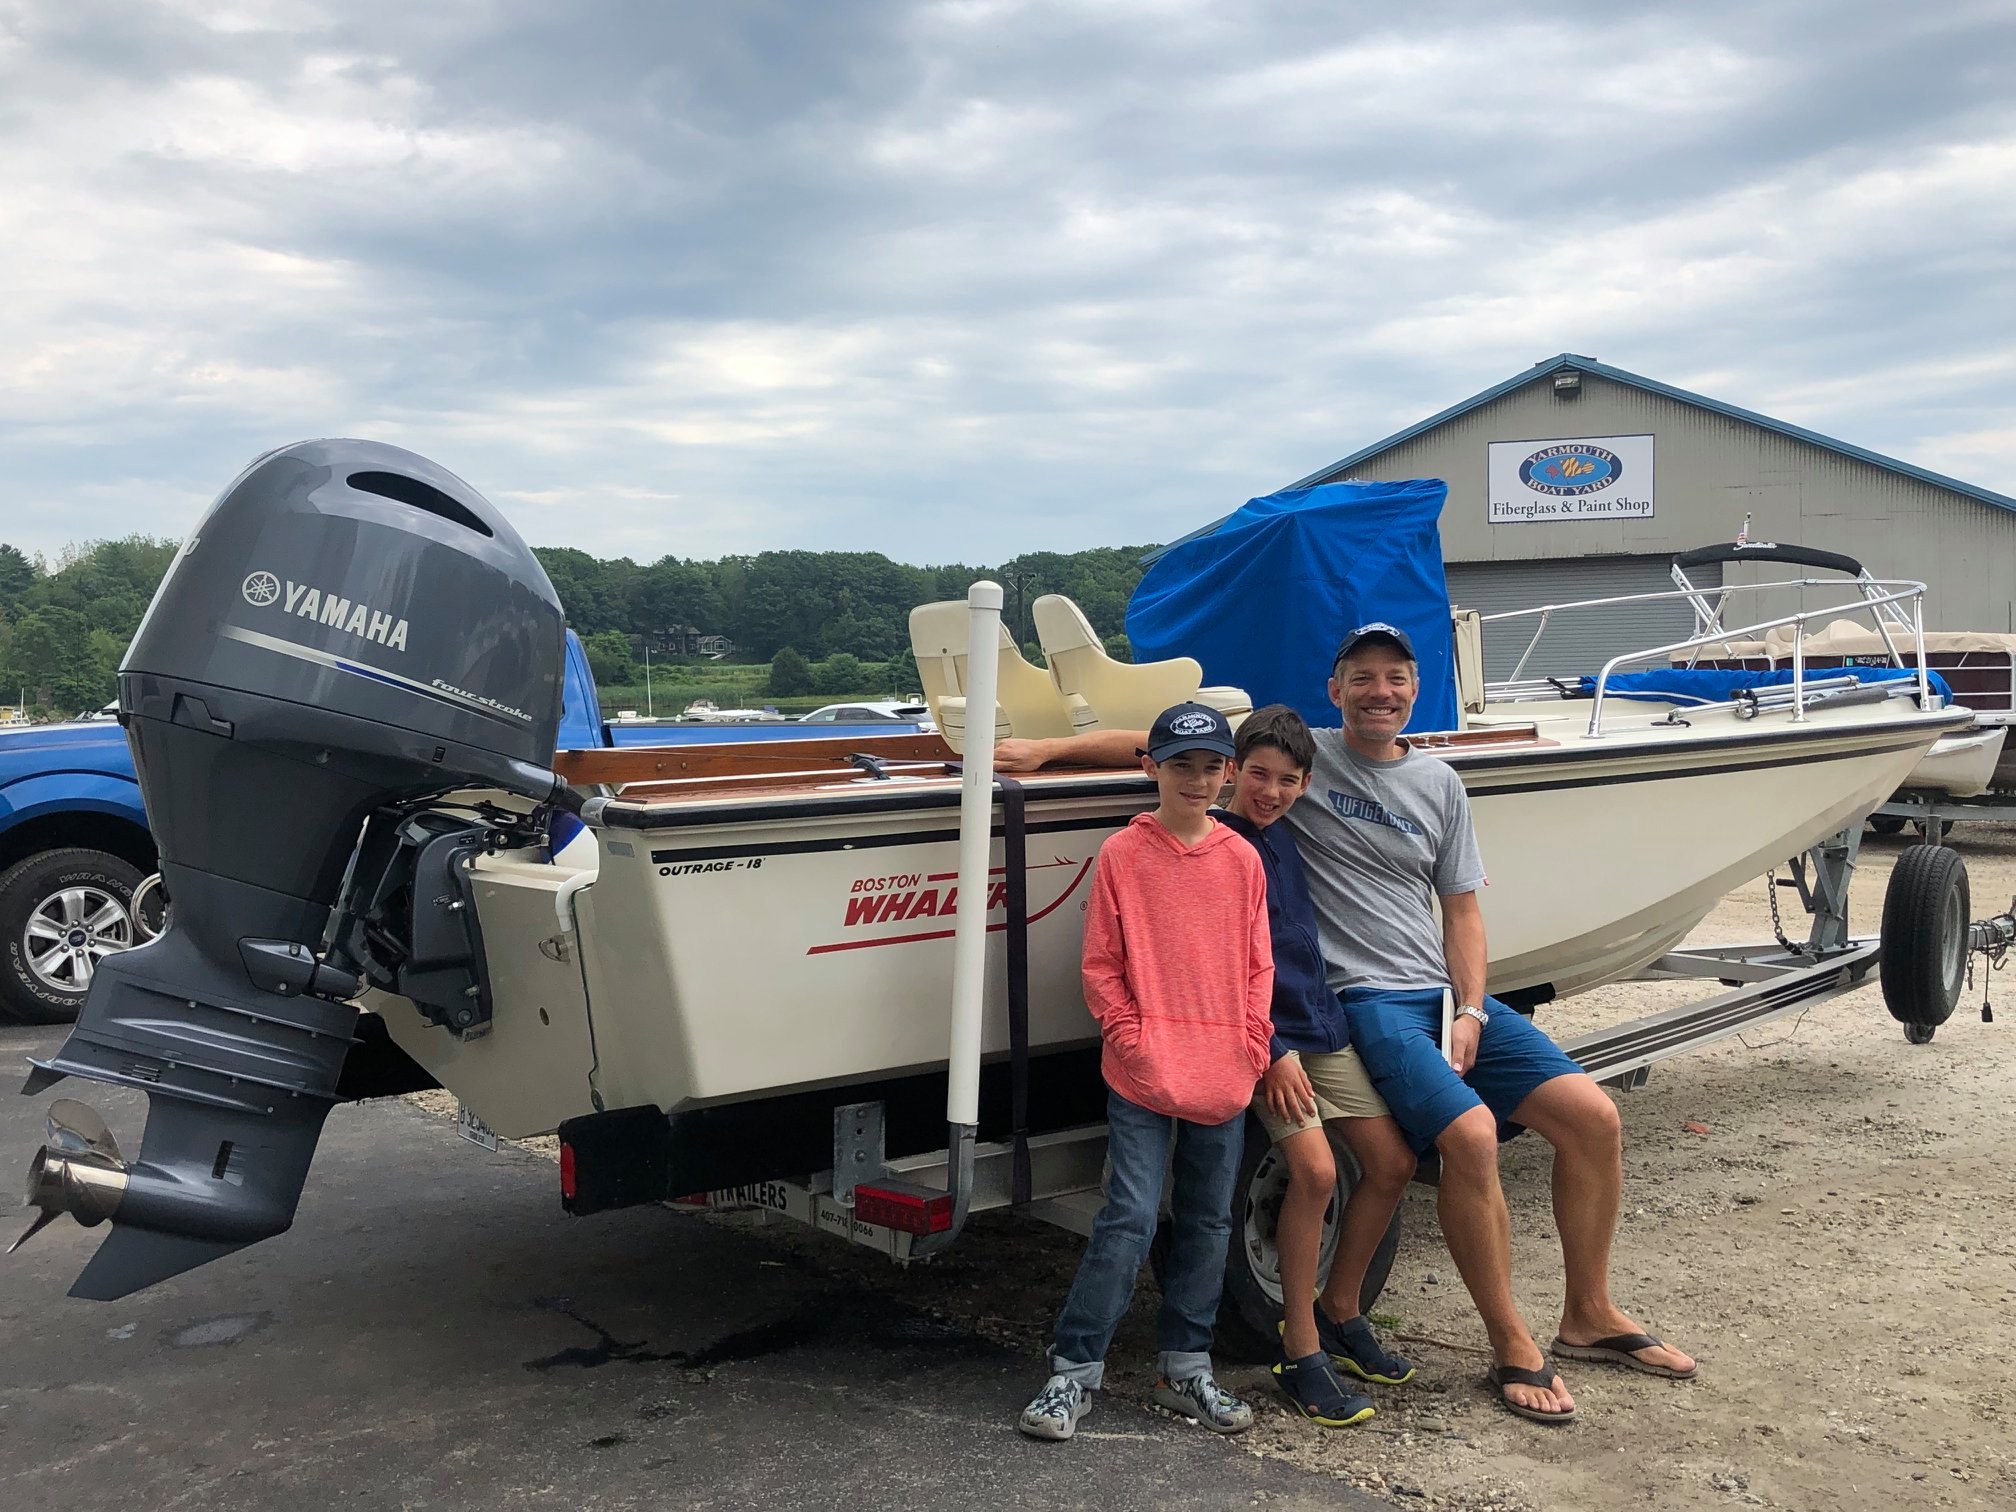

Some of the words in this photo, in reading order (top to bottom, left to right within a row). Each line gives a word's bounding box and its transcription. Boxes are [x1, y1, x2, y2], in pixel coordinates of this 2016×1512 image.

[1527, 444, 1613, 464] YARMOUTH
[1526, 478, 1569, 496] BOAT
[1571, 476, 1613, 495] YARD
[1493, 500, 1557, 518] Fiberglass
[1561, 501, 1574, 513] &
[1578, 499, 1612, 513] Paint
[1615, 497, 1650, 514] Shop
[284, 580, 409, 652] YAMAHA
[850, 873, 921, 893] BOSTON
[843, 881, 1008, 927] WHALR
